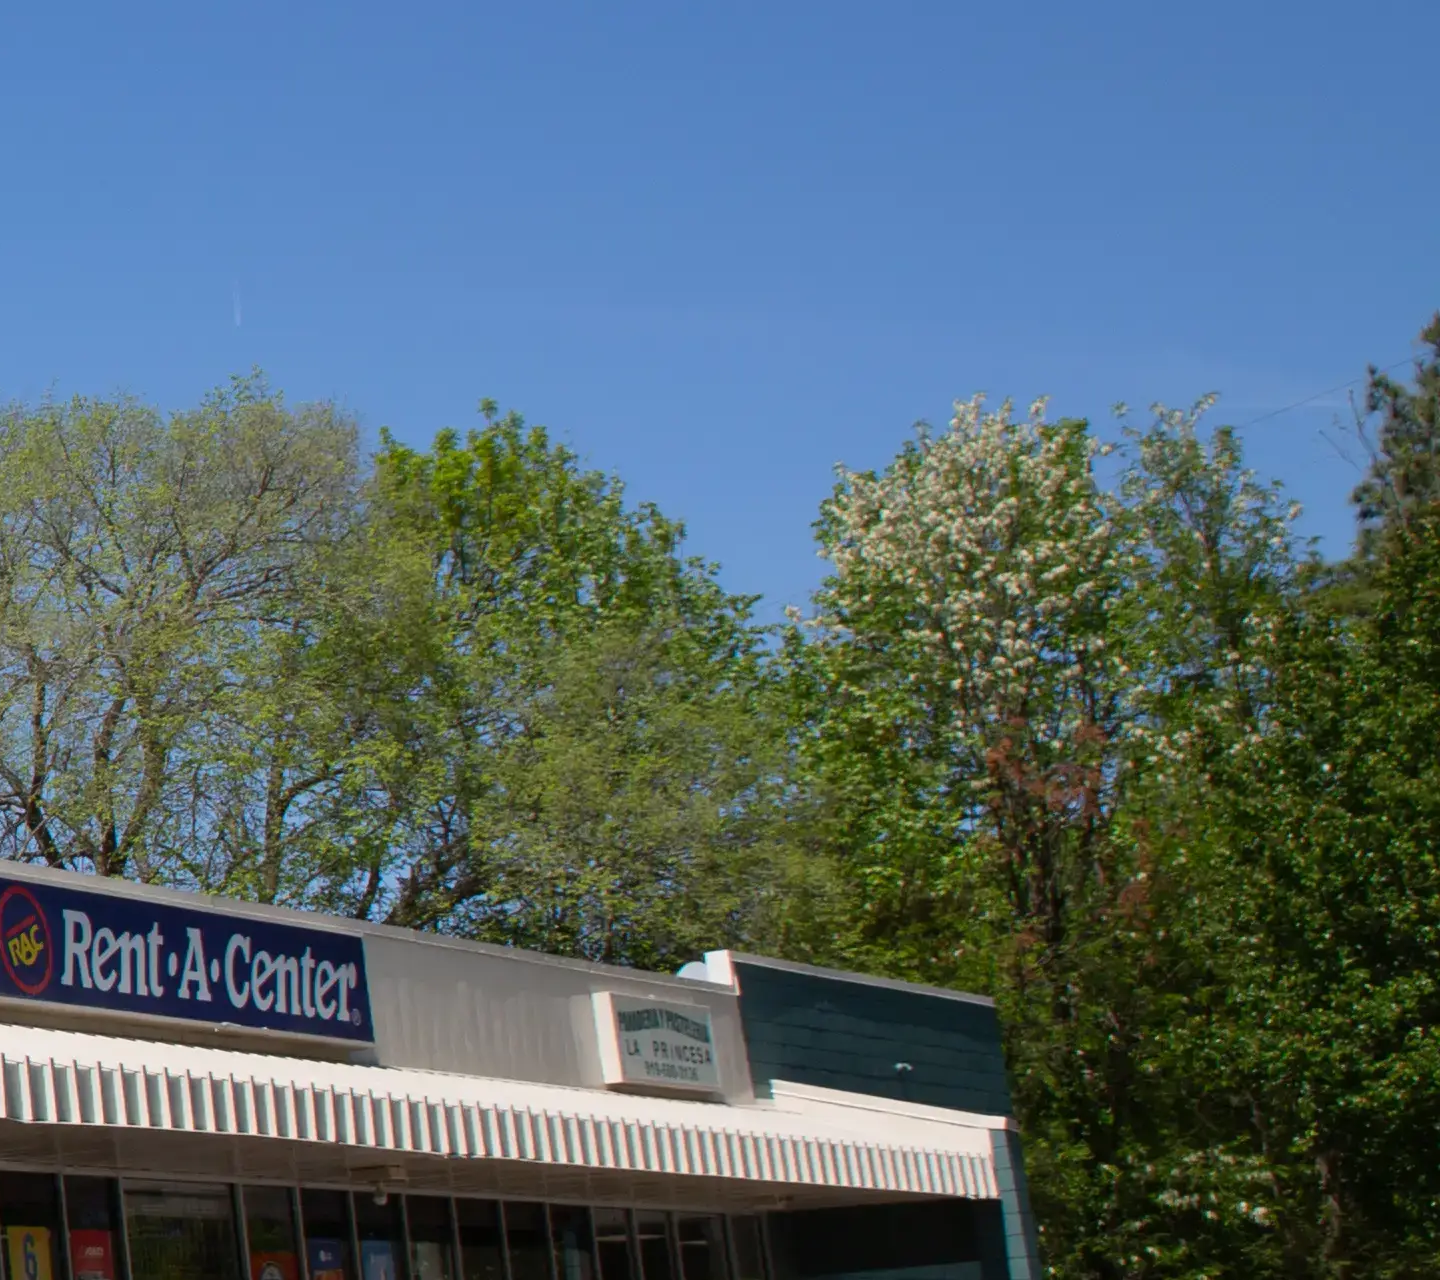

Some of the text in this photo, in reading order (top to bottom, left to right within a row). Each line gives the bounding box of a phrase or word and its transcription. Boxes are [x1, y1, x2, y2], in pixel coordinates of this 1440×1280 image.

[7, 924, 44, 967] RAC
[625, 1038, 712, 1065] LA PRINCESA
